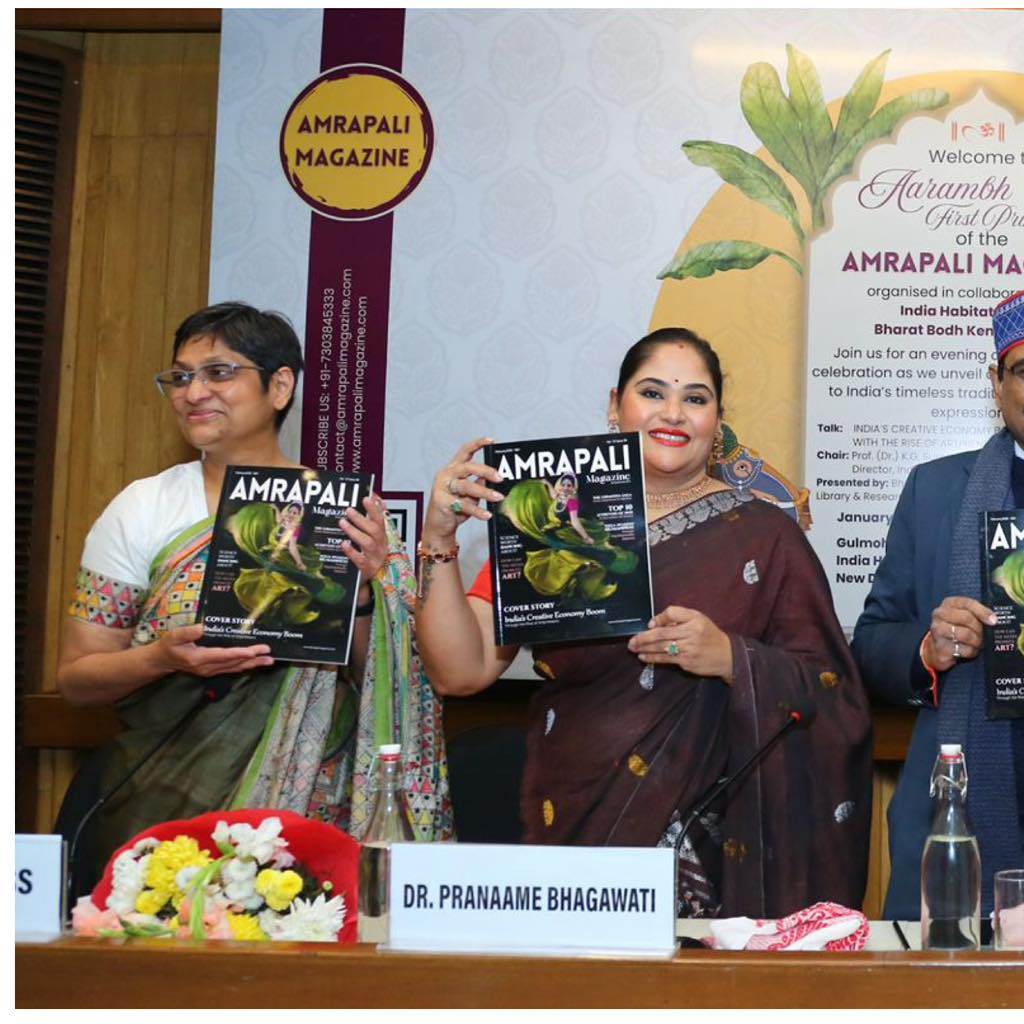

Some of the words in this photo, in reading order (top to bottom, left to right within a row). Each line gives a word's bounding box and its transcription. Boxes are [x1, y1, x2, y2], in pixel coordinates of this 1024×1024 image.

[297, 115, 410, 134] AMRAPALI
[295, 148, 409, 166] MAGAZINE
[929, 149, 1015, 165] Welcome
[858, 169, 1013, 213] Aarambh
[925, 204, 978, 231] First
[956, 231, 973, 246] of
[979, 232, 1008, 246] the
[842, 251, 973, 274] AMRAPALI
[867, 286, 938, 301] organised
[943, 286, 954, 298] in
[958, 287, 1017, 300] collabor
[900, 305, 936, 317] India
[940, 305, 994, 318] Habitat
[874, 323, 923, 335] Bharat
[927, 324, 963, 336] Bodh
[833, 347, 862, 360] Join
[866, 350, 882, 360] us
[886, 347, 905, 360] for
[909, 350, 927, 360] an
[931, 348, 987, 364] evening
[336, 268, 352, 473] ontact@amrapalimagazine.com
[812, 366, 892, 379] celebration
[896, 369, 913, 379] as
[916, 369, 936, 379] we
[940, 368, 982, 380] unveil
[828, 386, 843, 397] to
[846, 385, 891, 398] India's
[895, 386, 954, 399] timeless
[817, 424, 843, 433] Talk:
[317, 416, 330, 470] UBSCRIBE
[852, 438, 878, 447] WITH
[497, 444, 630, 480] AMRAPALI
[817, 451, 849, 460] Chair:
[816, 479, 870, 488] Presented
[873, 479, 889, 489] by:
[229, 477, 359, 507] AMRAPALI
[816, 492, 850, 502] Library
[836, 555, 870, 566] India
[836, 573, 865, 583] New
[404, 884, 433, 908] DR.
[439, 884, 542, 911] PRANAAME
[548, 886, 655, 912] BHAGAWATI
